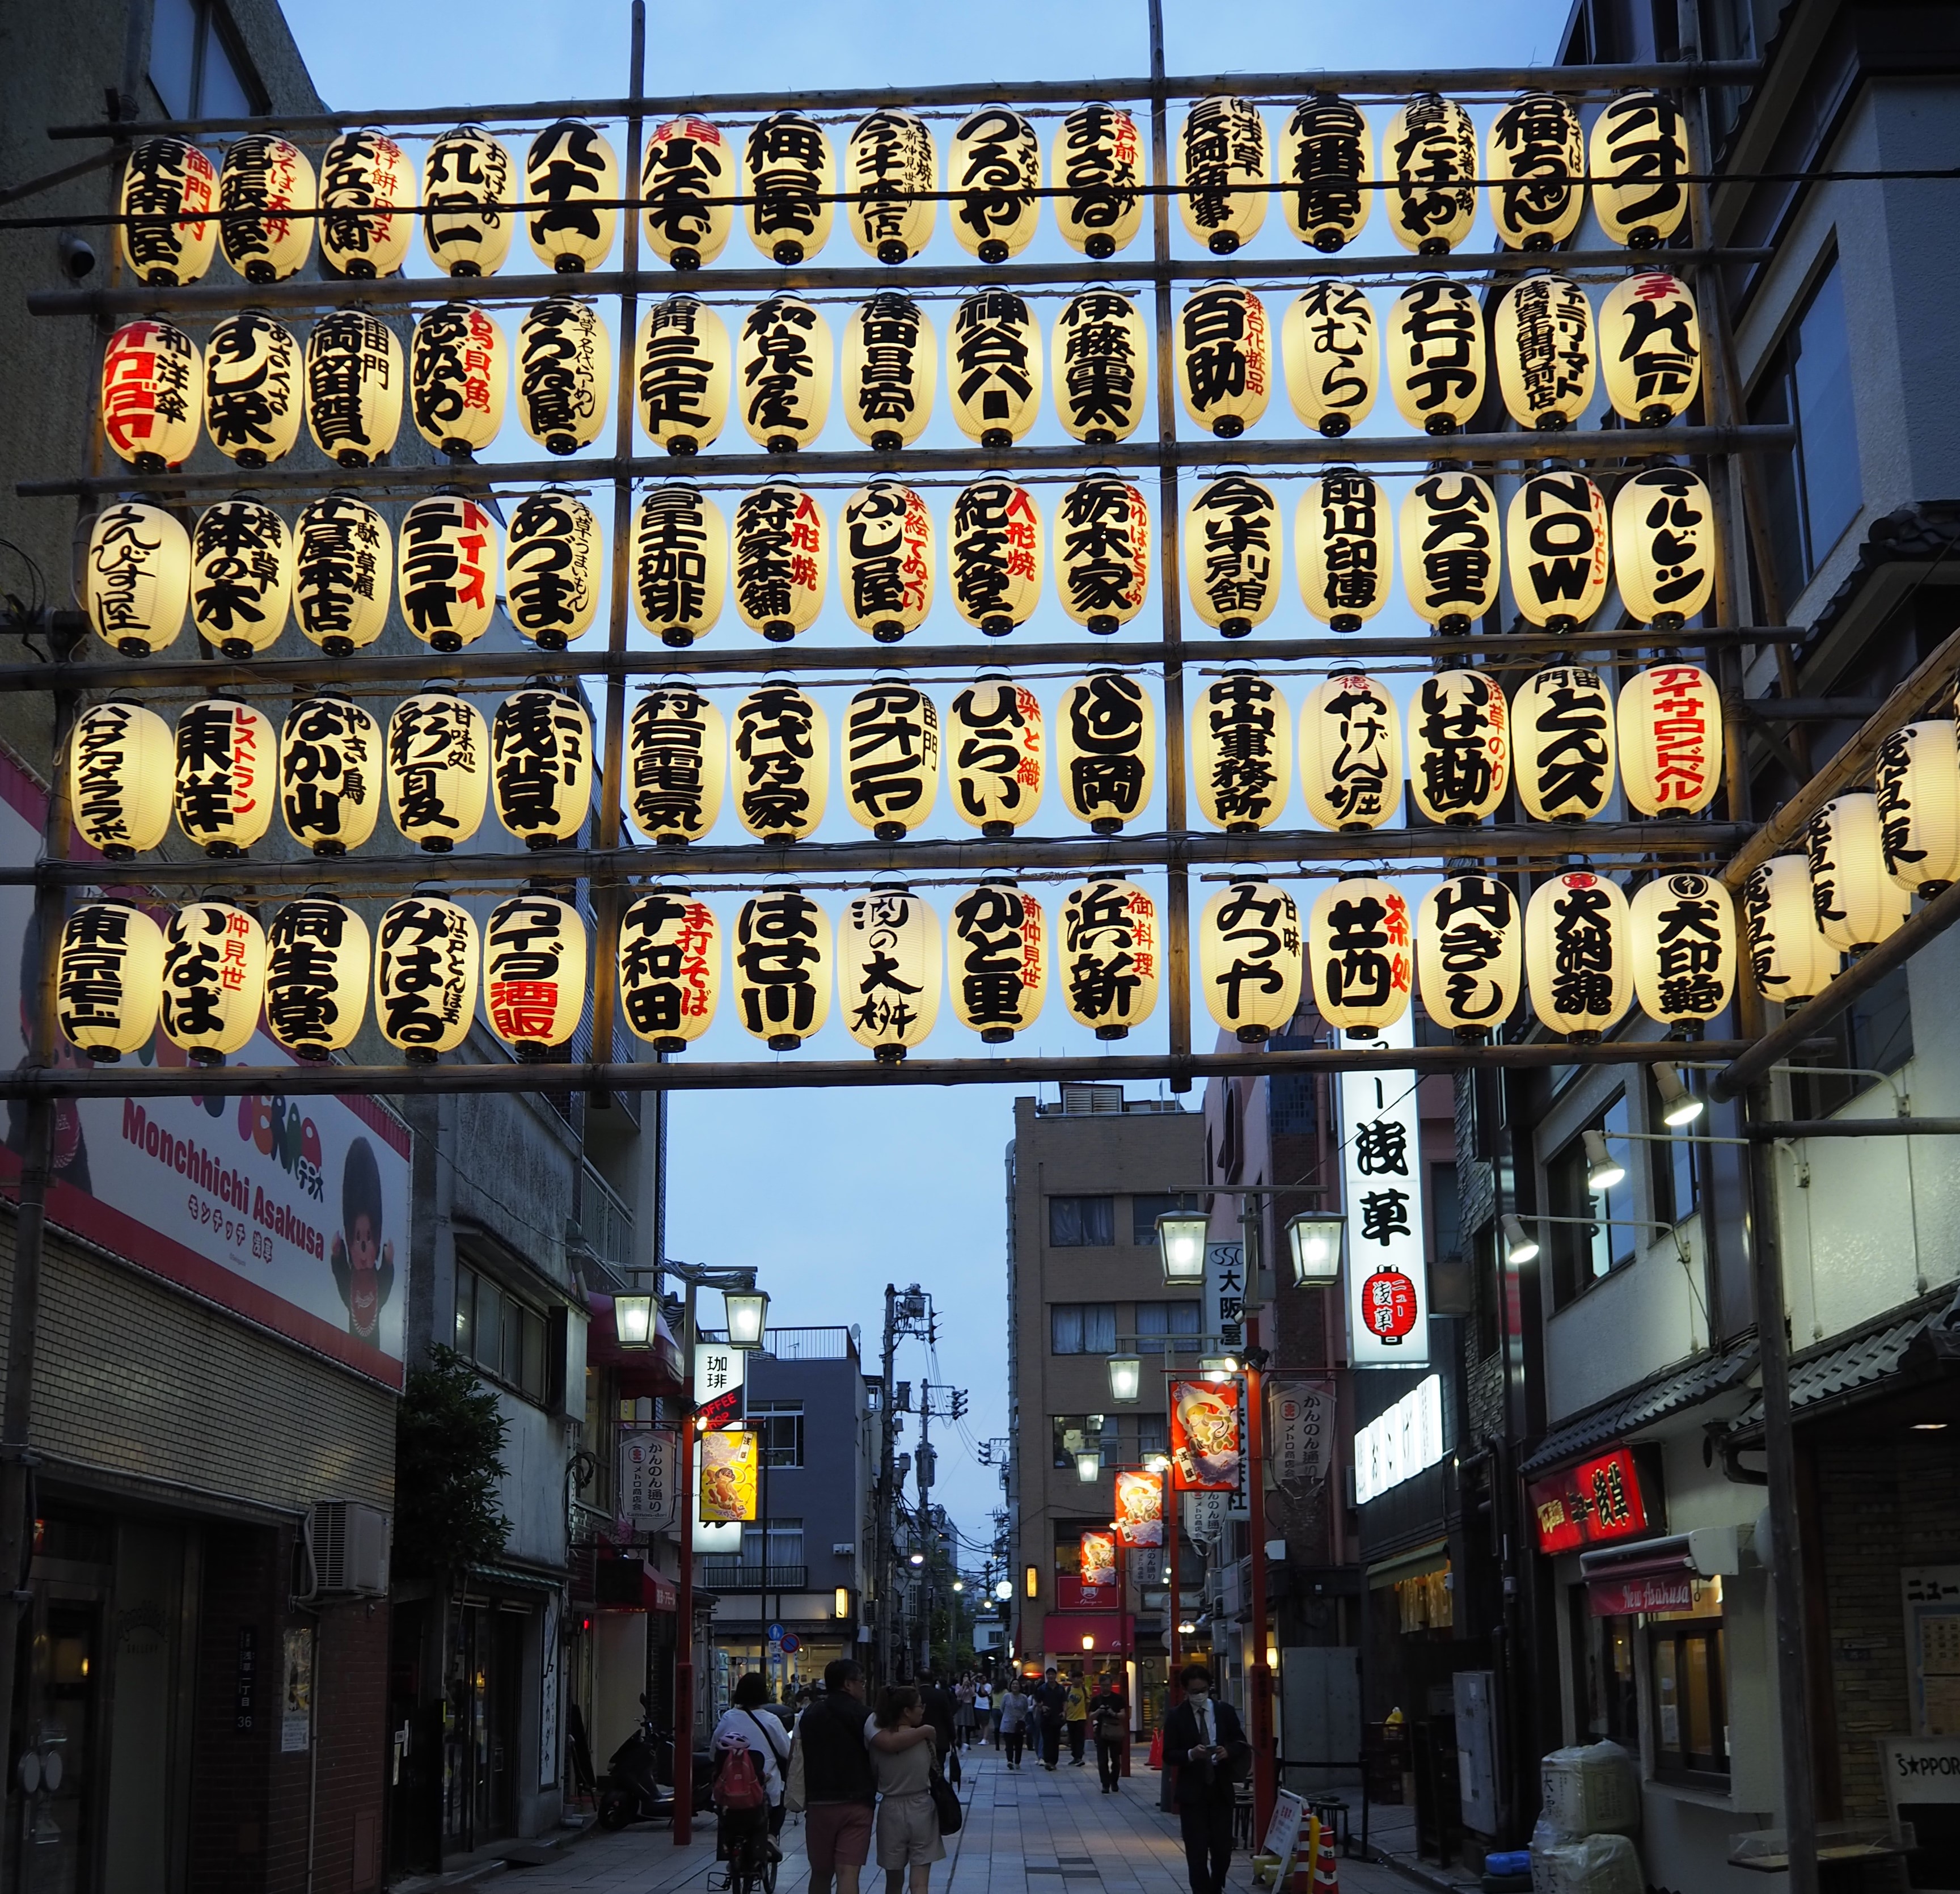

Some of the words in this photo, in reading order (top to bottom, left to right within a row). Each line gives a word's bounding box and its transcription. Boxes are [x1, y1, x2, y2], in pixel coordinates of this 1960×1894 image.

[956, 110, 1021, 238] つるや
[1065, 107, 1118, 227] まさる
[103, 321, 159, 450] オカダヤ
[155, 324, 192, 424] 和・洋傘
[208, 315, 276, 446] すし栄
[268, 323, 294, 416] あさくさ
[361, 313, 390, 390] 雷門
[743, 295, 817, 431] 和泉屋
[955, 290, 1033, 420] 神谷バー
[1183, 289, 1247, 412] 百助
[1299, 280, 1371, 408] 松むら
[1401, 284, 1477, 410] アゼリア
[1514, 280, 1556, 411] 浅草雷門前店
[1551, 277, 1590, 398] ファミリーマート
[91, 505, 162, 636] えびす屋
[195, 503, 269, 630] 鉢の木
[248, 507, 282, 594] 浅草
[508, 495, 575, 628] あづま
[638, 491, 707, 622] 富士珈琲
[735, 488, 797, 620] 木村家本舗
[790, 492, 821, 592] 人形焼
[846, 483, 907, 619] ふじ屋
[901, 487, 931, 611] 染絵てぬぐい
[954, 483, 1014, 619] 紀文堂
[1005, 487, 1038, 583] 人形焼
[1192, 478, 1275, 614] 今半別館
[1526, 475, 1595, 605] NOW
[174, 704, 235, 837] 東洋
[232, 707, 257, 813] レストラン
[284, 700, 344, 838] なか山
[340, 707, 369, 805] やき鳥
[447, 703, 476, 773] 甘味処
[554, 699, 583, 786] ニュー
[631, 692, 710, 832] 村石電気
[921, 691, 939, 773] 雷門
[952, 686, 1027, 817] ひらい
[1017, 686, 1042, 794] 染と織
[1209, 677, 1279, 821] 中山事務所
[1324, 690, 1388, 820] やげん堀
[1485, 676, 1506, 792] 浅草のり
[1650, 668, 1706, 803] アイサロンドベル
[59, 906, 130, 1042] 東京モード
[162, 908, 227, 1037] いなば
[219, 912, 250, 992] 仲見世
[381, 901, 450, 1044] みはる
[440, 908, 469, 1027] 江戸とんぼ玉
[622, 897, 687, 1034] 十和田
[675, 902, 715, 1017] 手打そば
[737, 893, 821, 1032] はせ川
[1019, 893, 1044, 989] 新仲見世
[1066, 884, 1143, 1020] 浜新
[1126, 891, 1155, 980] 御料理
[1215, 884, 1285, 1020] みつや
[1280, 889, 1301, 957] 甘味
[1383, 893, 1412, 994] 茶処
[122, 1096, 250, 1215] Monchhichi
[253, 1185, 325, 1262] Asakusa
[188, 1194, 246, 1246] モンチッチ
[252, 1230, 273, 1264] 浅草
[298, 1159, 324, 1203] テラオ
[1371, 1280, 1393, 1332] 浅草
[707, 1355, 728, 1389] 珈琲
[632, 1465, 643, 1511] メトロ商店会
[648, 1442, 664, 1512] かんのん通り
[1302, 1395, 1321, 1479] かんのん通り
[1623, 1584, 1642, 1609] New
[1643, 1581, 1690, 1609] Asakusa
[237, 1716, 252, 1728] 36
